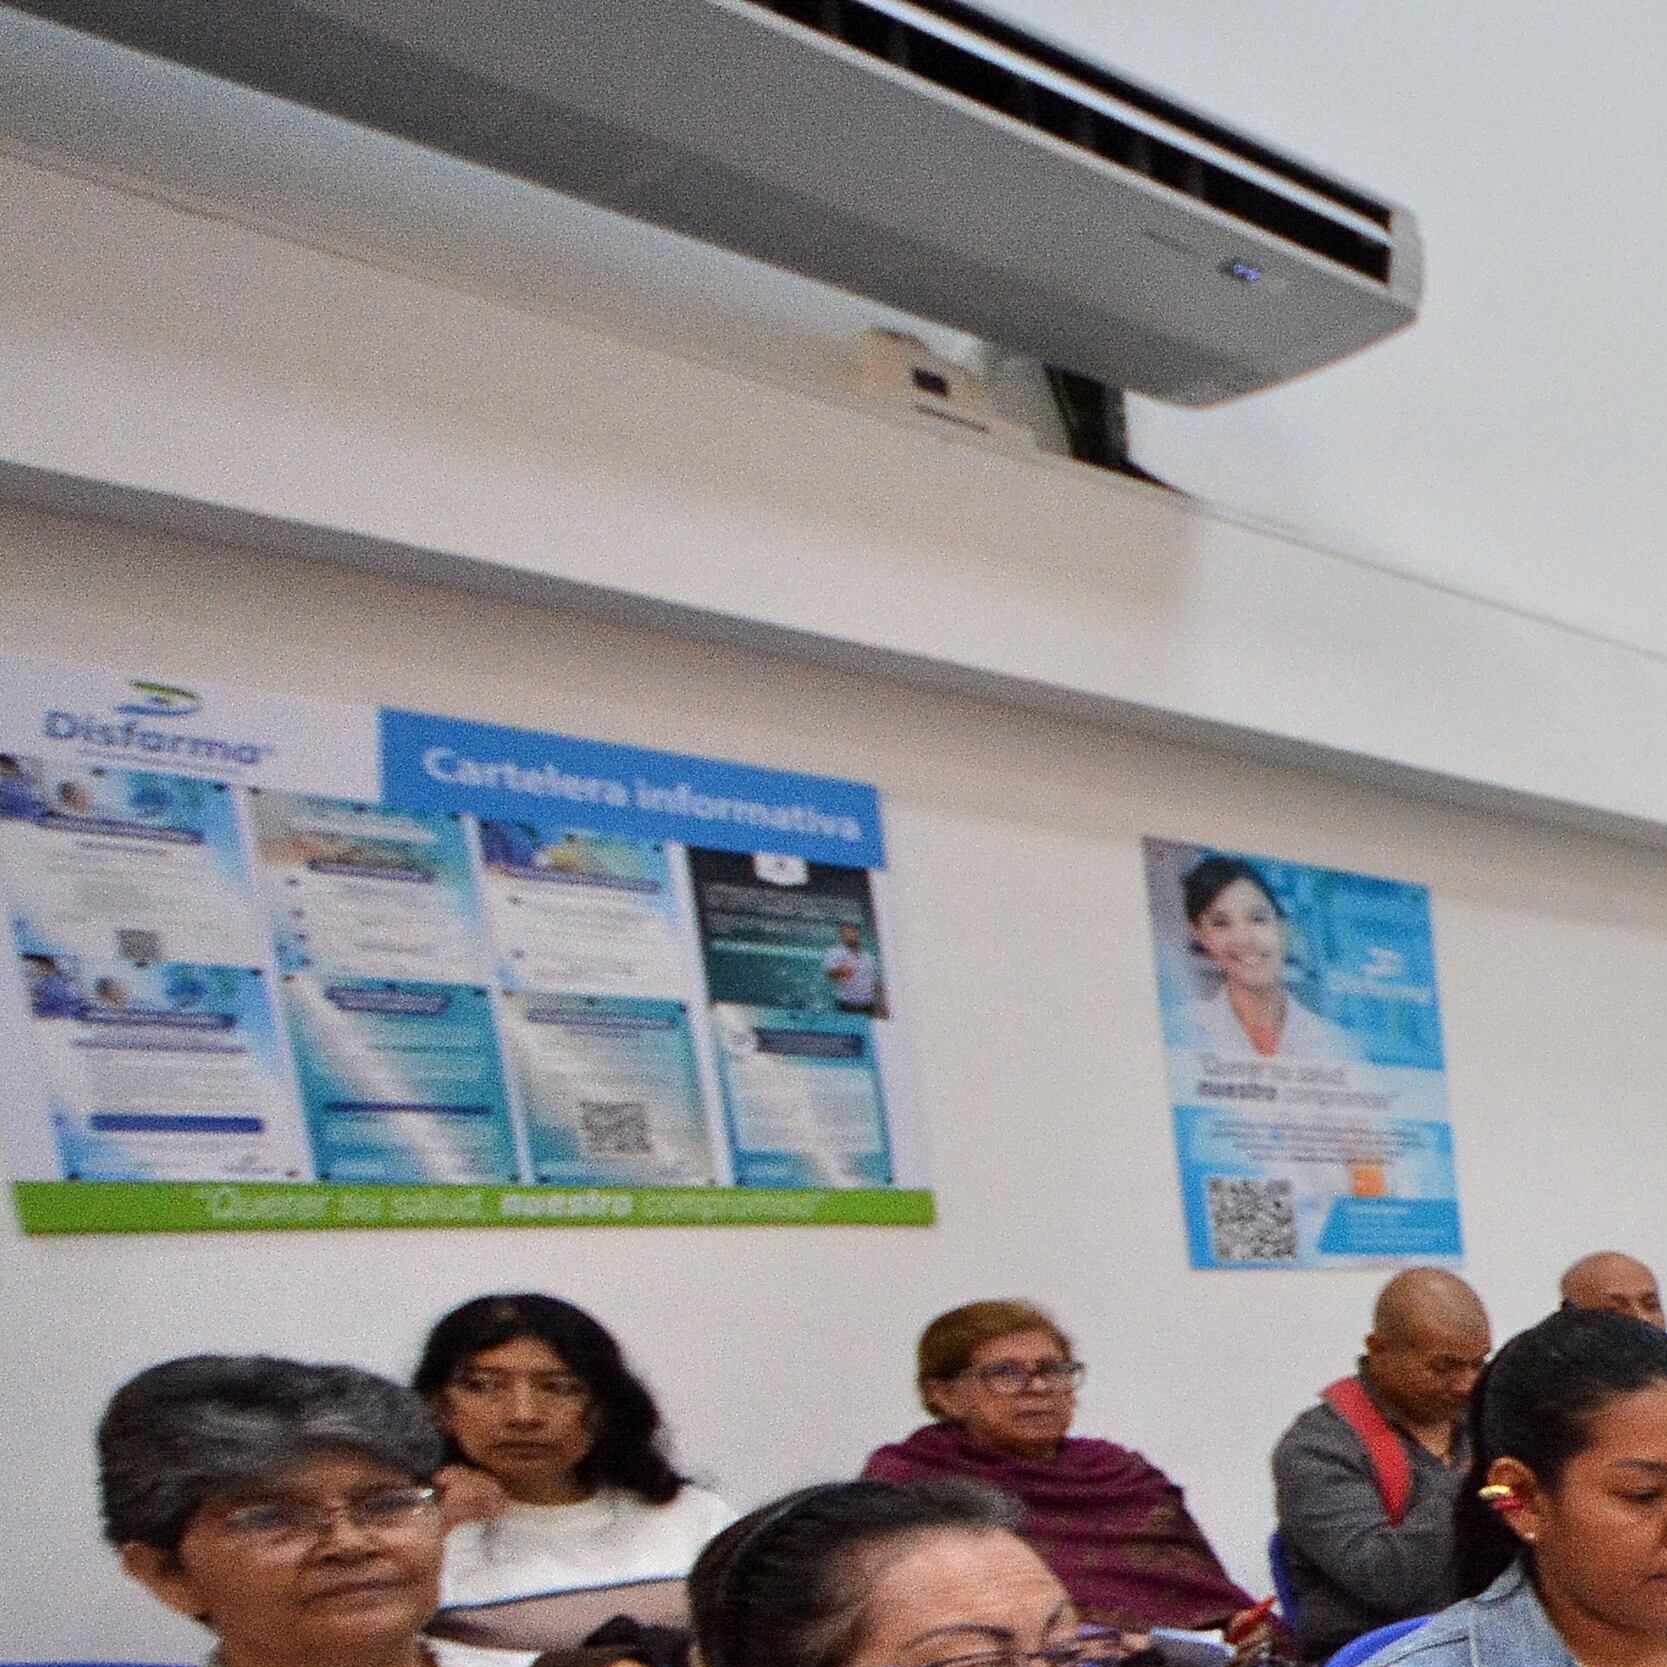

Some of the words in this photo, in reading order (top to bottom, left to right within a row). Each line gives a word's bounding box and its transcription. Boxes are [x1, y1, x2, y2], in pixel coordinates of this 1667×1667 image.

[45, 708, 262, 764] Disfarma
[422, 746, 629, 806] Cartelera
[634, 777, 864, 841] informativa
